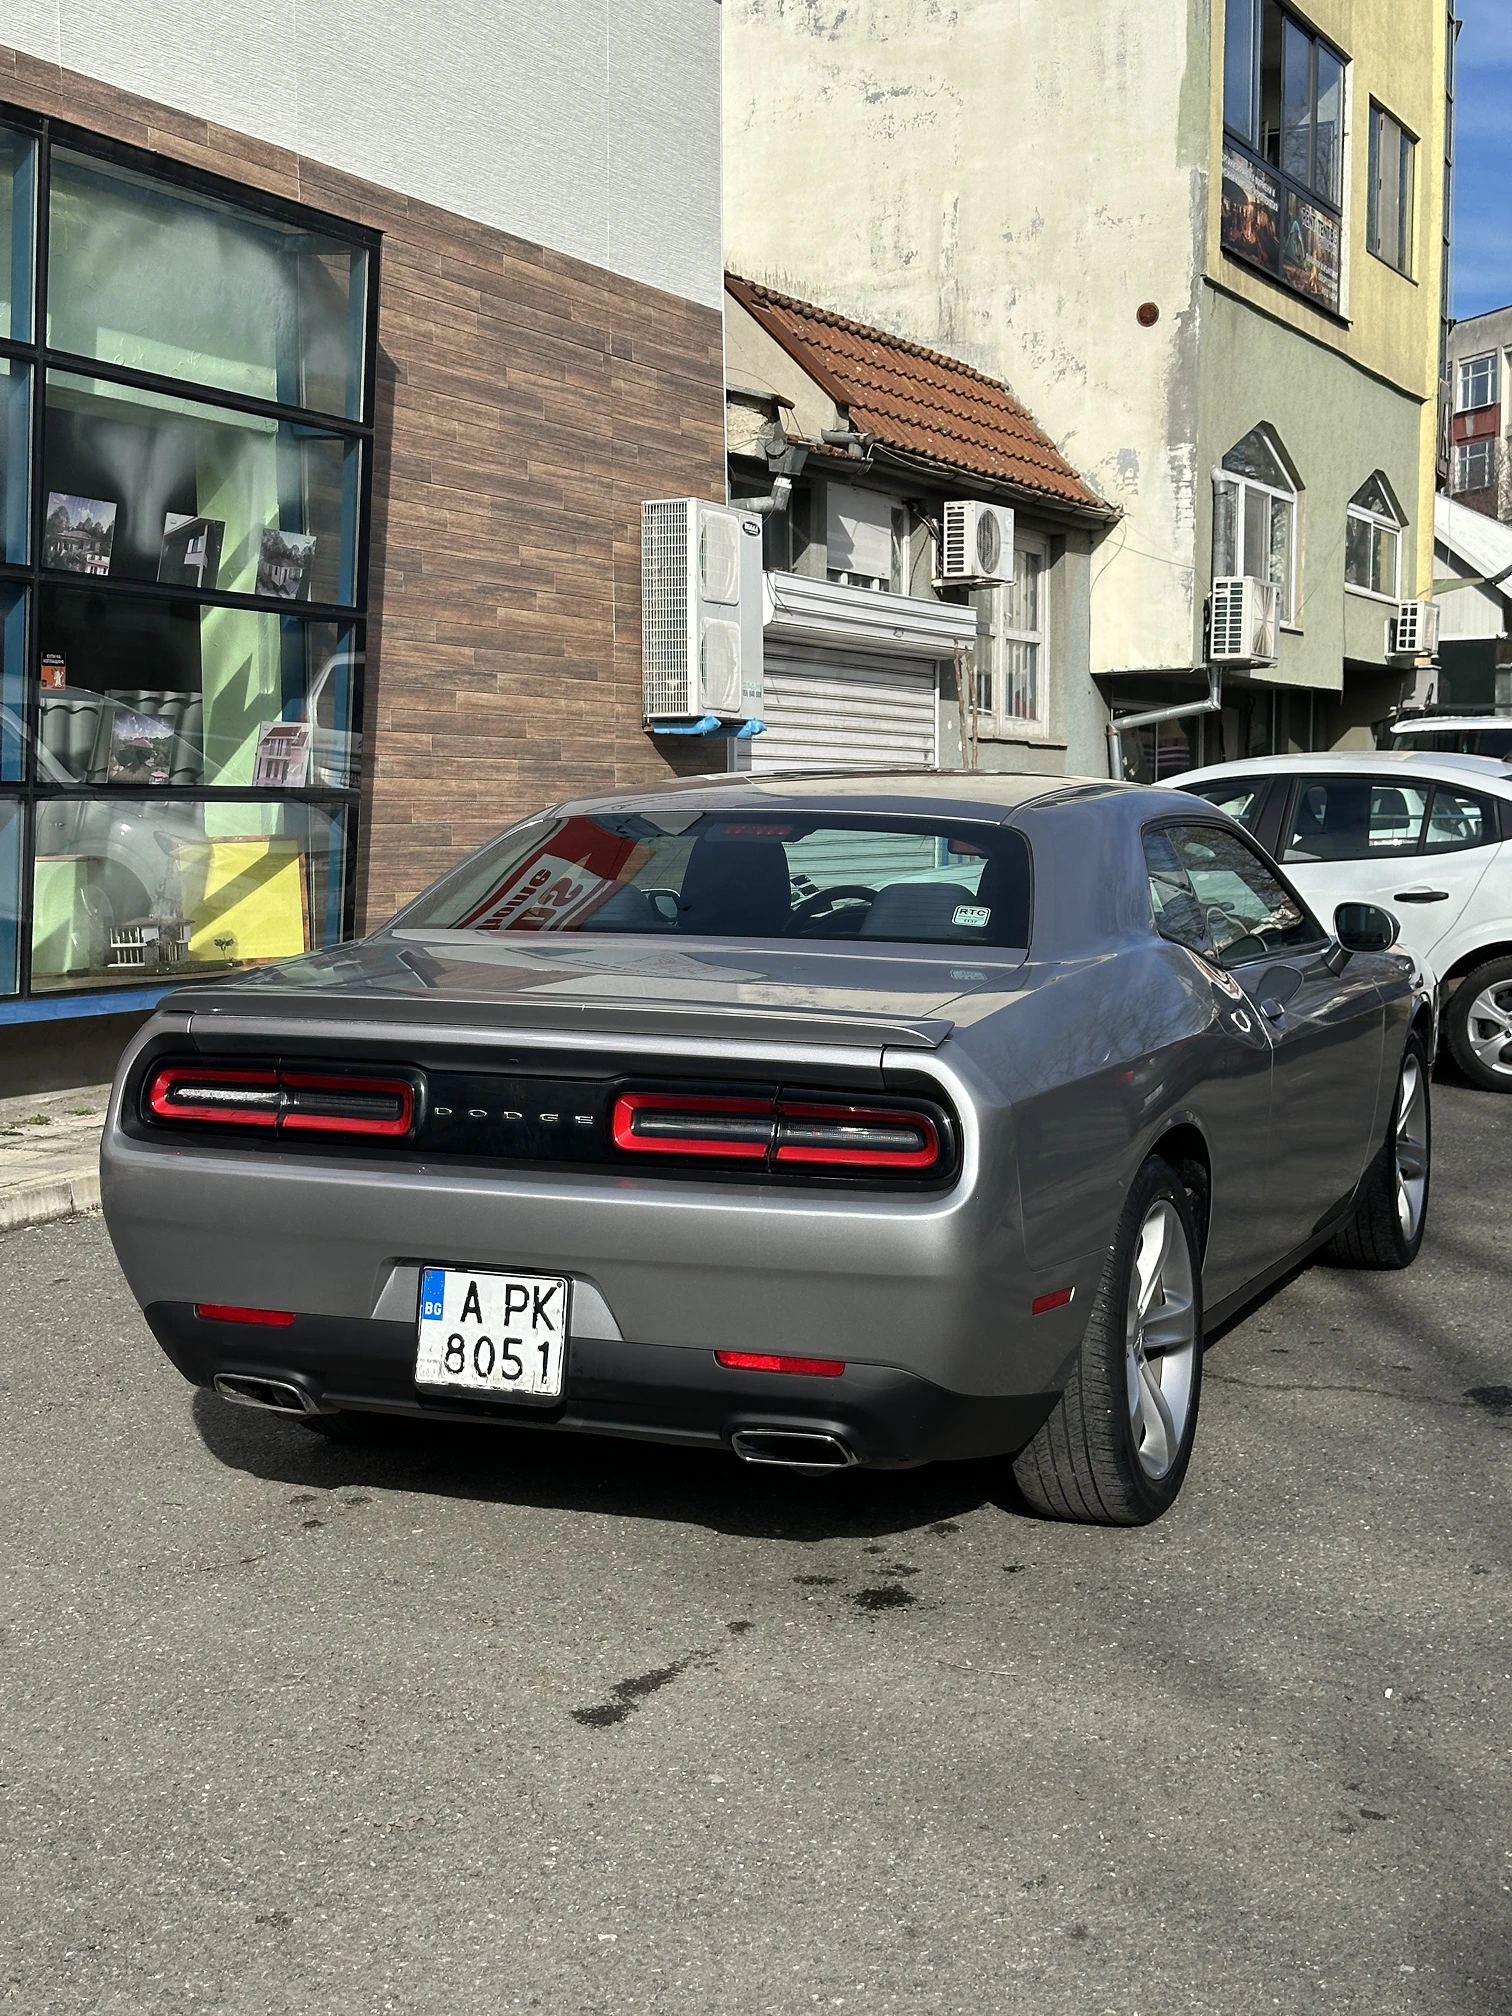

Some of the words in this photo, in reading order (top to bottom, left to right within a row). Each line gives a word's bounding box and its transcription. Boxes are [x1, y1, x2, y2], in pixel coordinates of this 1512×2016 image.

[959, 908, 987, 917] RTC
[434, 1106, 595, 1125] DODGE
[424, 1301, 443, 1316] BG
[460, 1280, 483, 1324] A
[503, 1283, 557, 1331] PK
[444, 1332, 550, 1385] 8051
